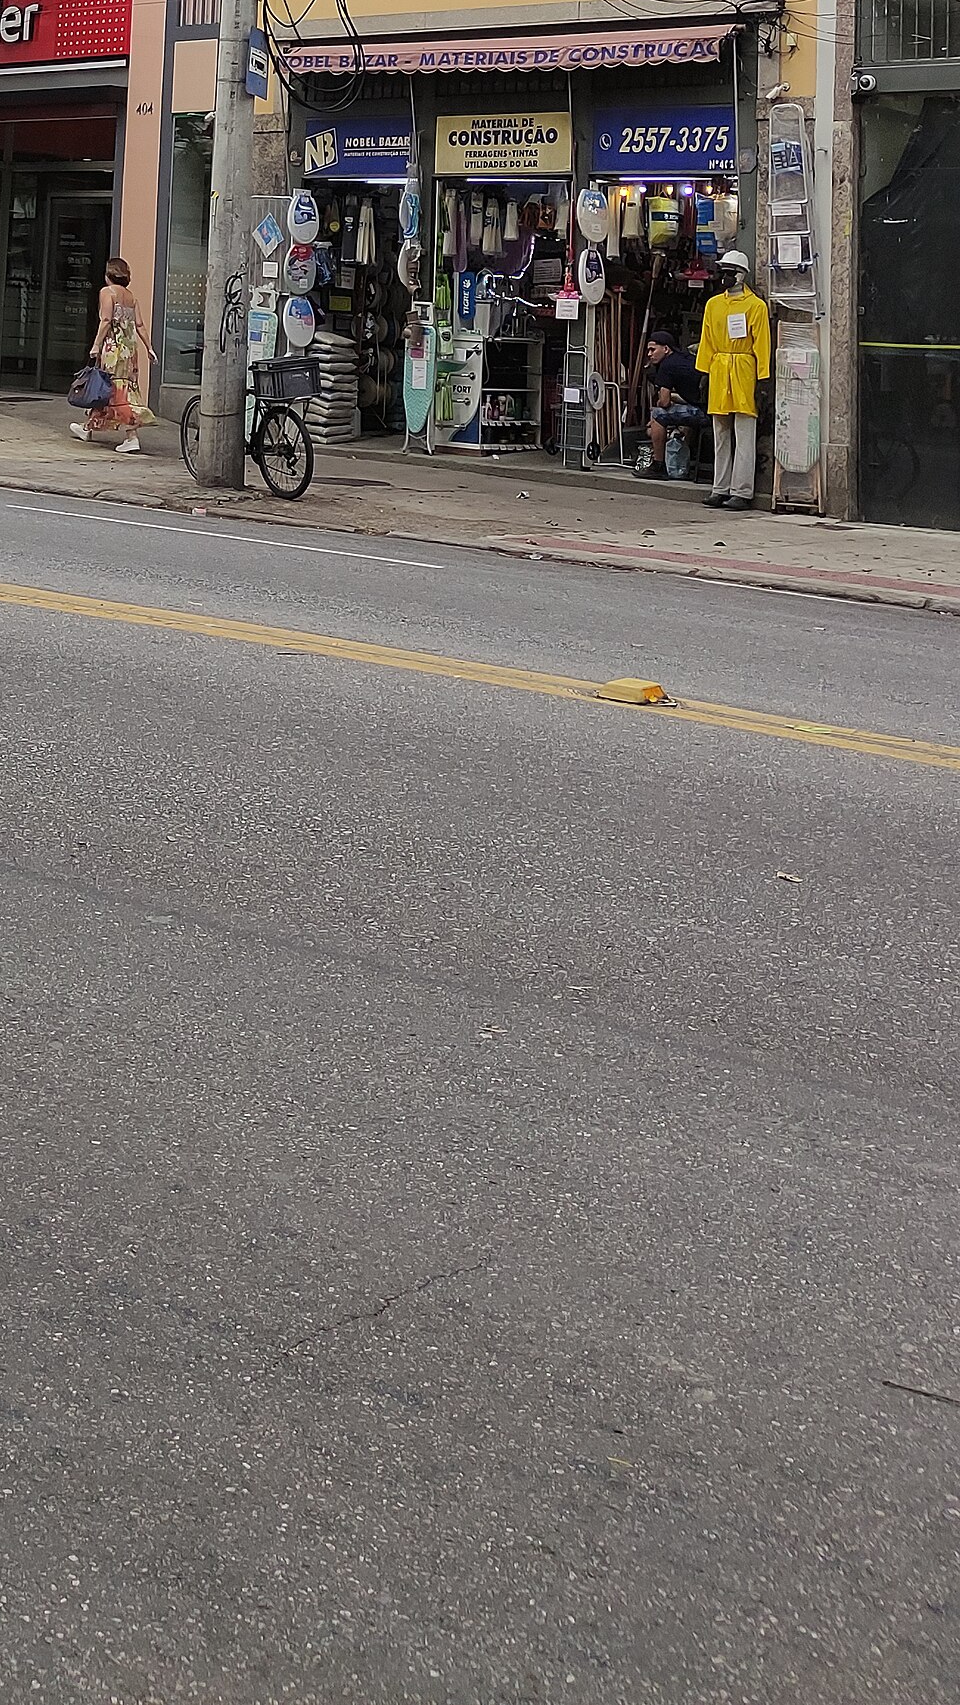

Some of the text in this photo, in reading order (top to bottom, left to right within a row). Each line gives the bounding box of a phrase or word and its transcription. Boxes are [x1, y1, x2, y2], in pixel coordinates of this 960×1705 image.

[339, 54, 399, 68] BAZAR
[419, 50, 528, 67] MATERIAIS
[534, 49, 560, 64] DE
[135, 101, 154, 116] 404
[471, 117, 535, 129] MATERIAL DE
[344, 136, 411, 148] NOBEL BAZAR
[448, 124, 559, 147] CONSTRUÇÃO
[618, 126, 730, 153] 2557-3375
[464, 148, 539, 158] FERRAGENS TINTAS
[464, 159, 538, 169] UTILIDADES DO LAR
[462, 290, 470, 315] TIGRE
[452, 384, 472, 395] FORT
